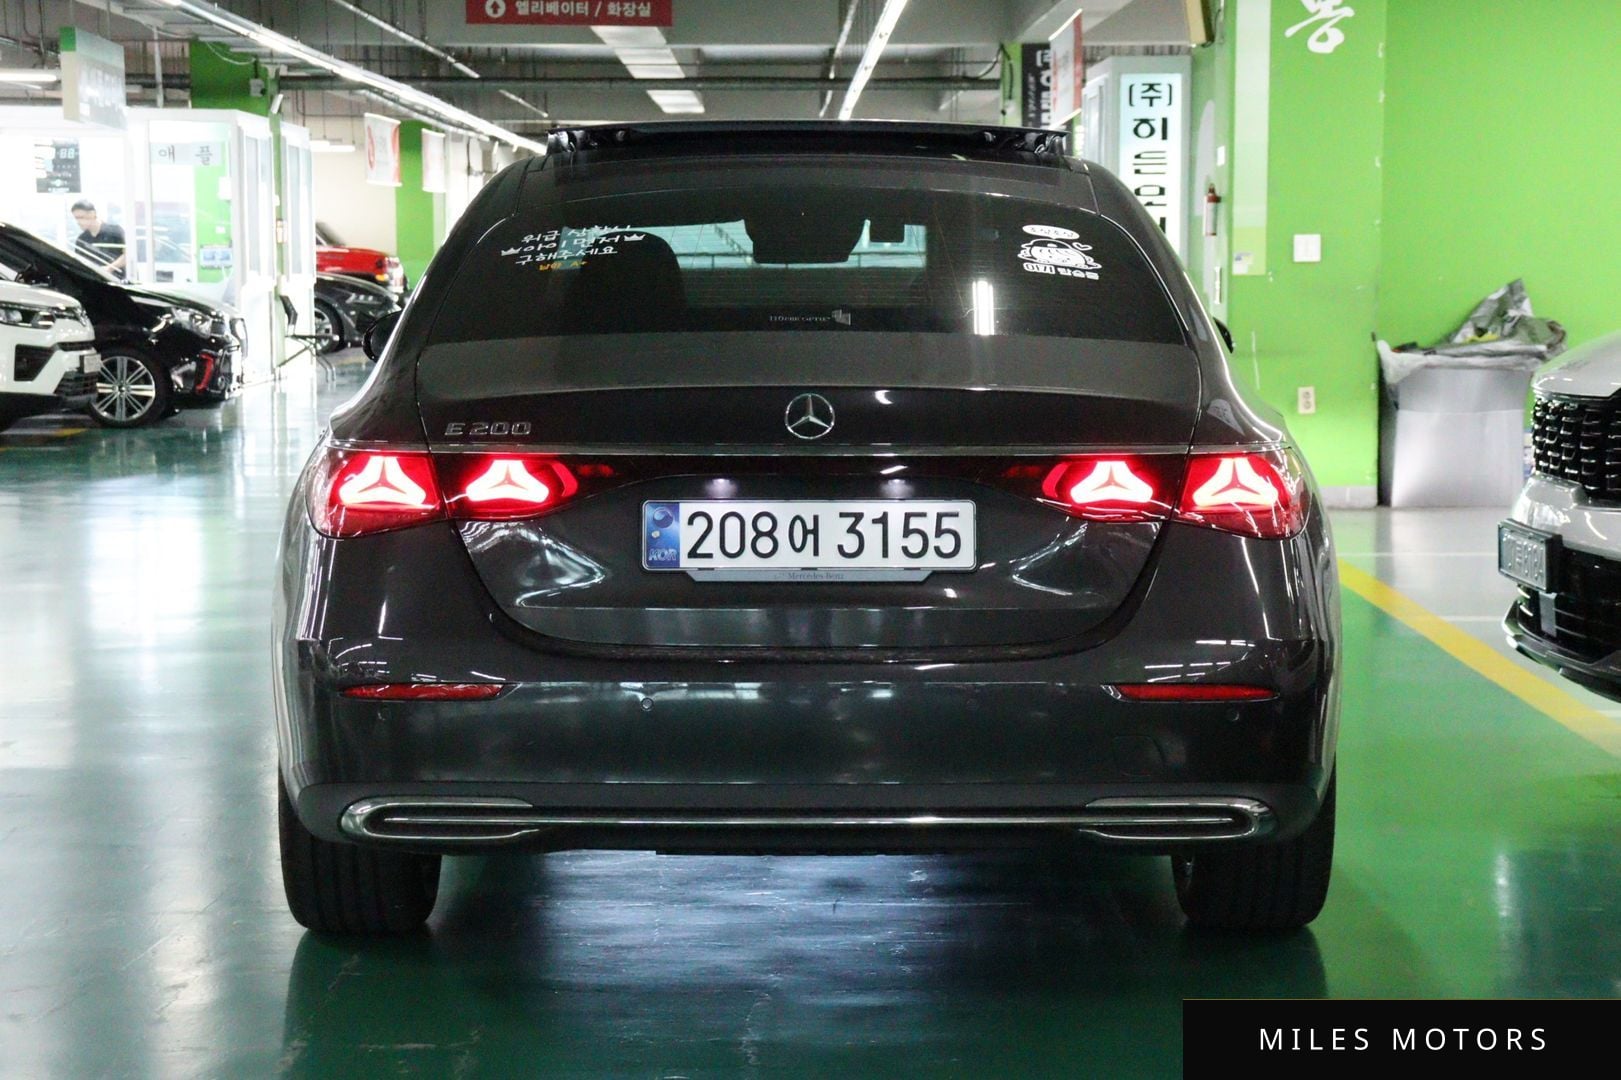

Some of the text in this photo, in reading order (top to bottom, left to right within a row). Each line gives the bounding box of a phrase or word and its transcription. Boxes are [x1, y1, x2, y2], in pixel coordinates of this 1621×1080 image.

[516, 0, 589, 16] 엘리베이터
[607, 2, 651, 17] 화장실
[523, 231, 560, 243] 위급
[573, 235, 620, 248] 먼저
[515, 246, 618, 265] 구해주세요
[445, 422, 532, 436] E 200
[687, 511, 962, 559] 208어 3155
[649, 550, 676, 561] KOR
